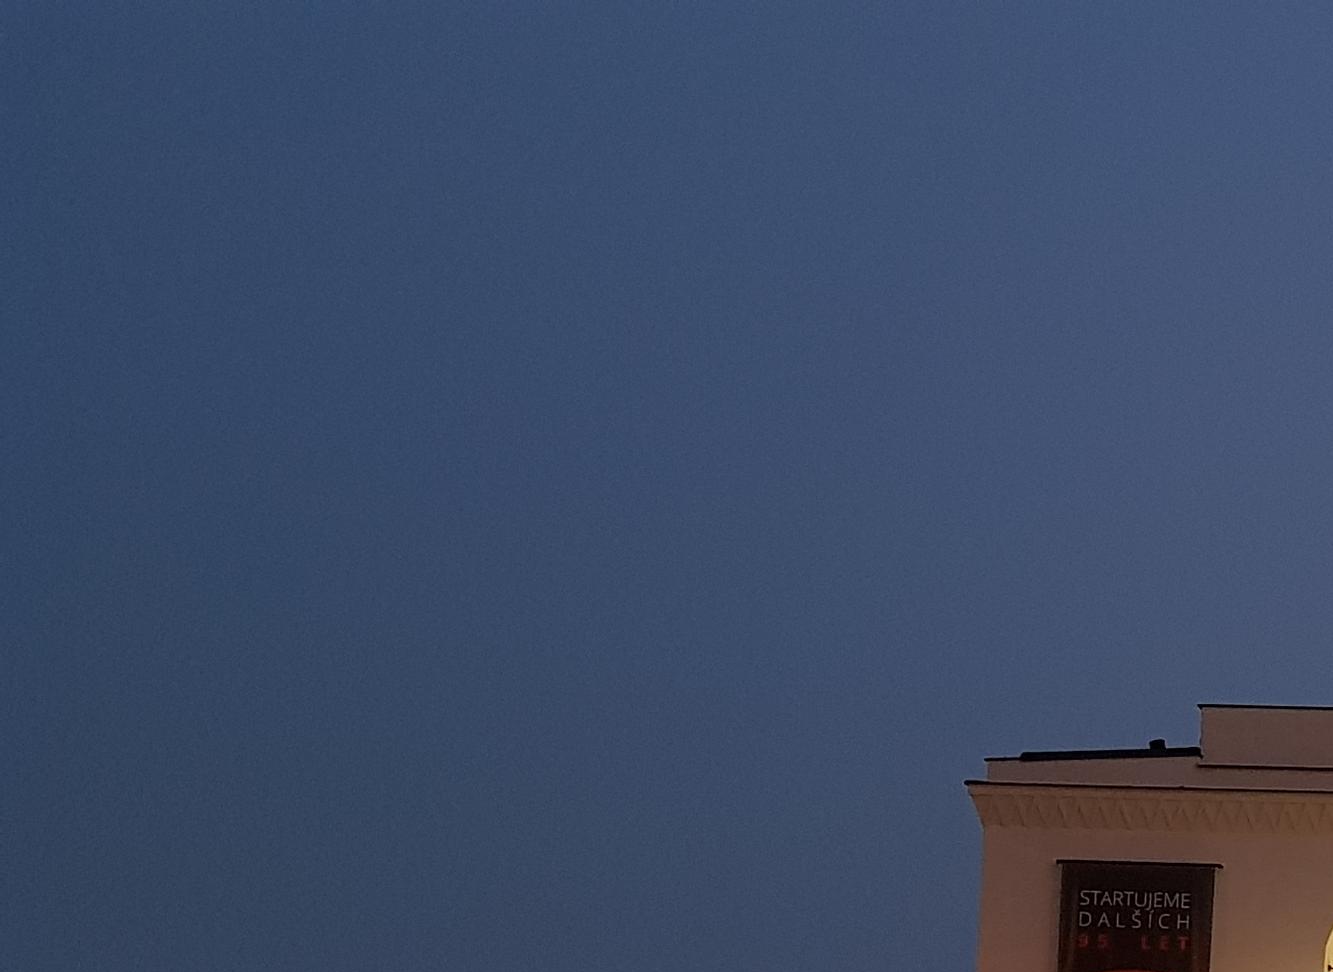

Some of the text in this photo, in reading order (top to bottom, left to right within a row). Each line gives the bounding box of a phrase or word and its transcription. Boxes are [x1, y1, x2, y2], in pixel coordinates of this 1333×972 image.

[1079, 890, 1191, 910] STARTUJEME
[1079, 909, 1190, 929] DALŠÍCH
[1141, 935, 1190, 949] LET
